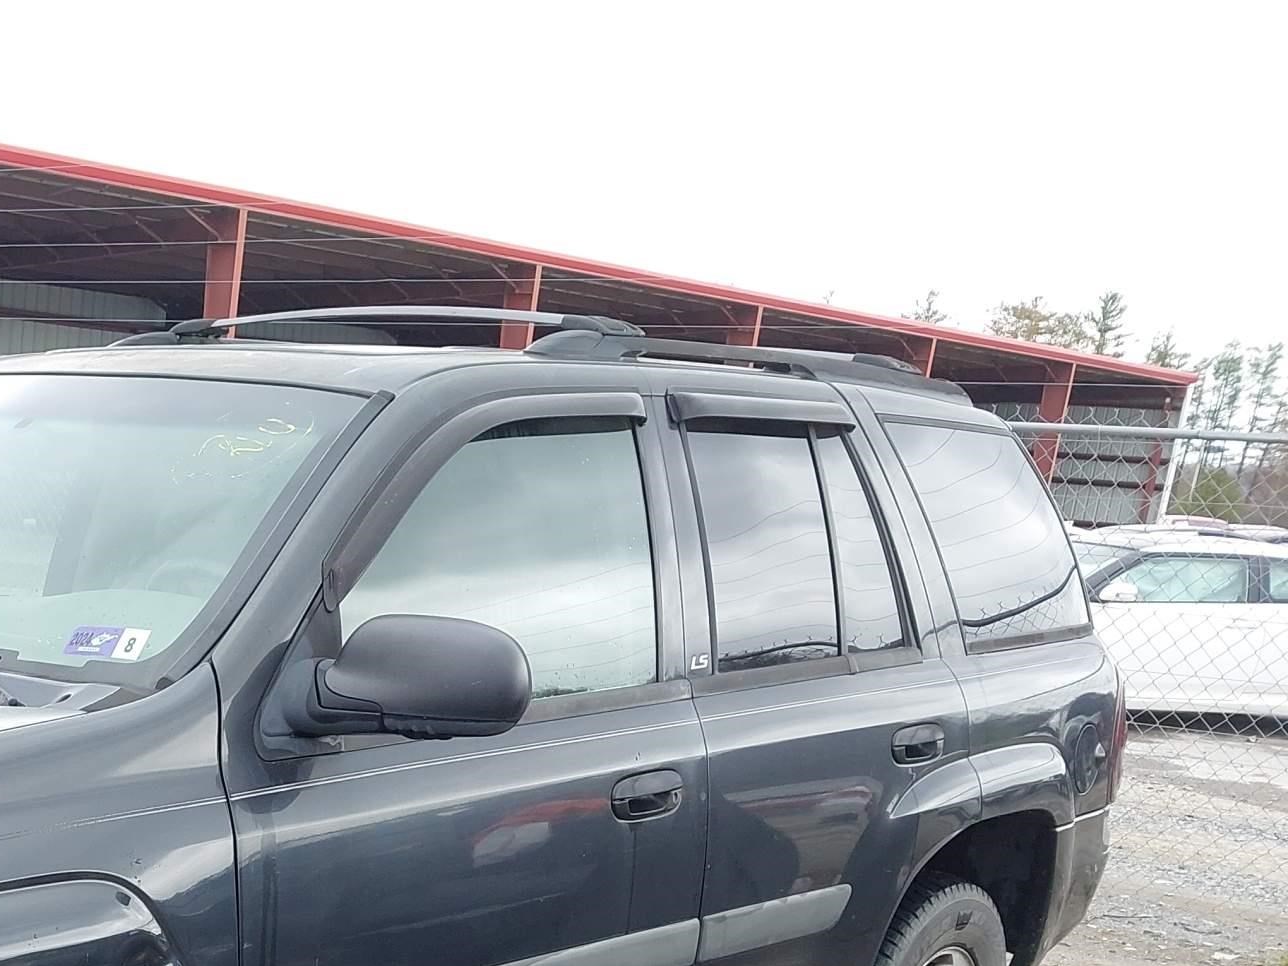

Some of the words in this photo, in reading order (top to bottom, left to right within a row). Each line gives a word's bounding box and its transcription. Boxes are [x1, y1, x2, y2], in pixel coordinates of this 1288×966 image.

[70, 631, 94, 647] 2024
[123, 636, 137, 654] 8
[690, 653, 709, 670] LS
